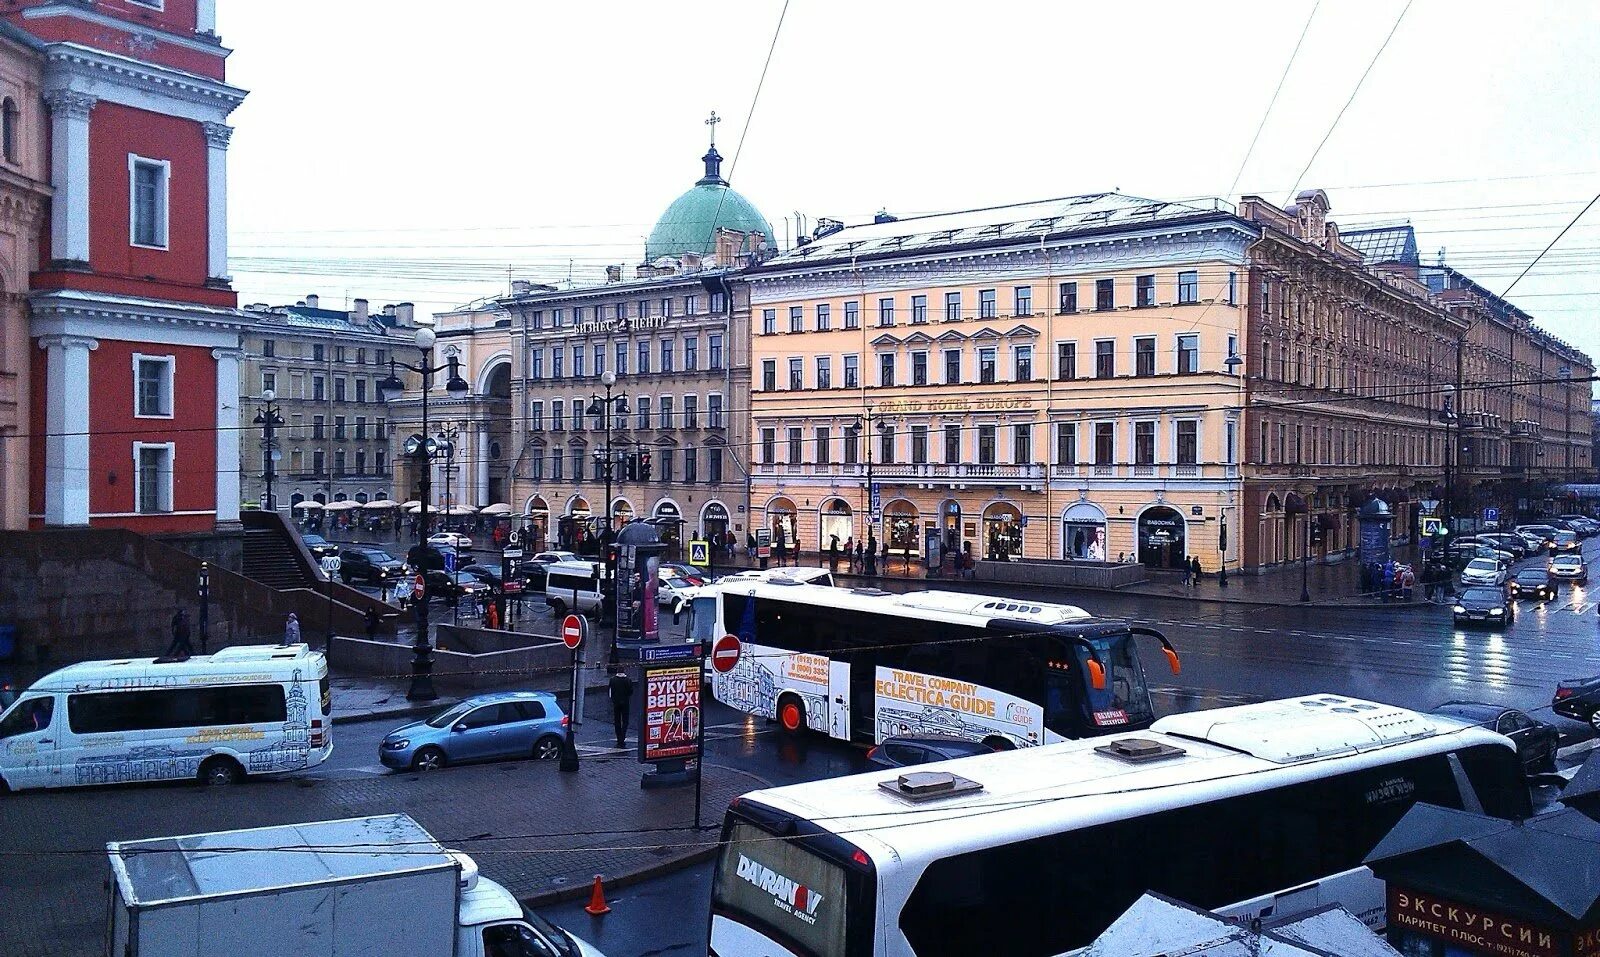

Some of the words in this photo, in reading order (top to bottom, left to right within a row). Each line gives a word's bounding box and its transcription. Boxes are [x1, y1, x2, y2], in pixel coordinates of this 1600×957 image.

[573, 320, 613, 334] БИЗНЕС
[632, 315, 667, 330] ЦЕНТР
[878, 400, 922, 412] GRAND
[928, 398, 972, 410] HOTEL
[976, 396, 1032, 409] EUROPE
[648, 680, 686, 696] РУКИ
[893, 671, 927, 688] TRAVEL
[928, 677, 978, 697] COMPANY
[876, 680, 996, 717] ECLECTICA-GUIDE
[1015, 706, 1030, 715] CITY
[663, 705, 700, 743] 20
[1012, 714, 1033, 724] GUIDE
[774, 898, 792, 913] TRAVEL
[794, 909, 816, 926] AGENCY
[1398, 893, 1551, 949] ЭКСКУРСИИ
[1398, 913, 1446, 935] ПАРИТЕТ
[1451, 928, 1485, 947] ПЛЮС
